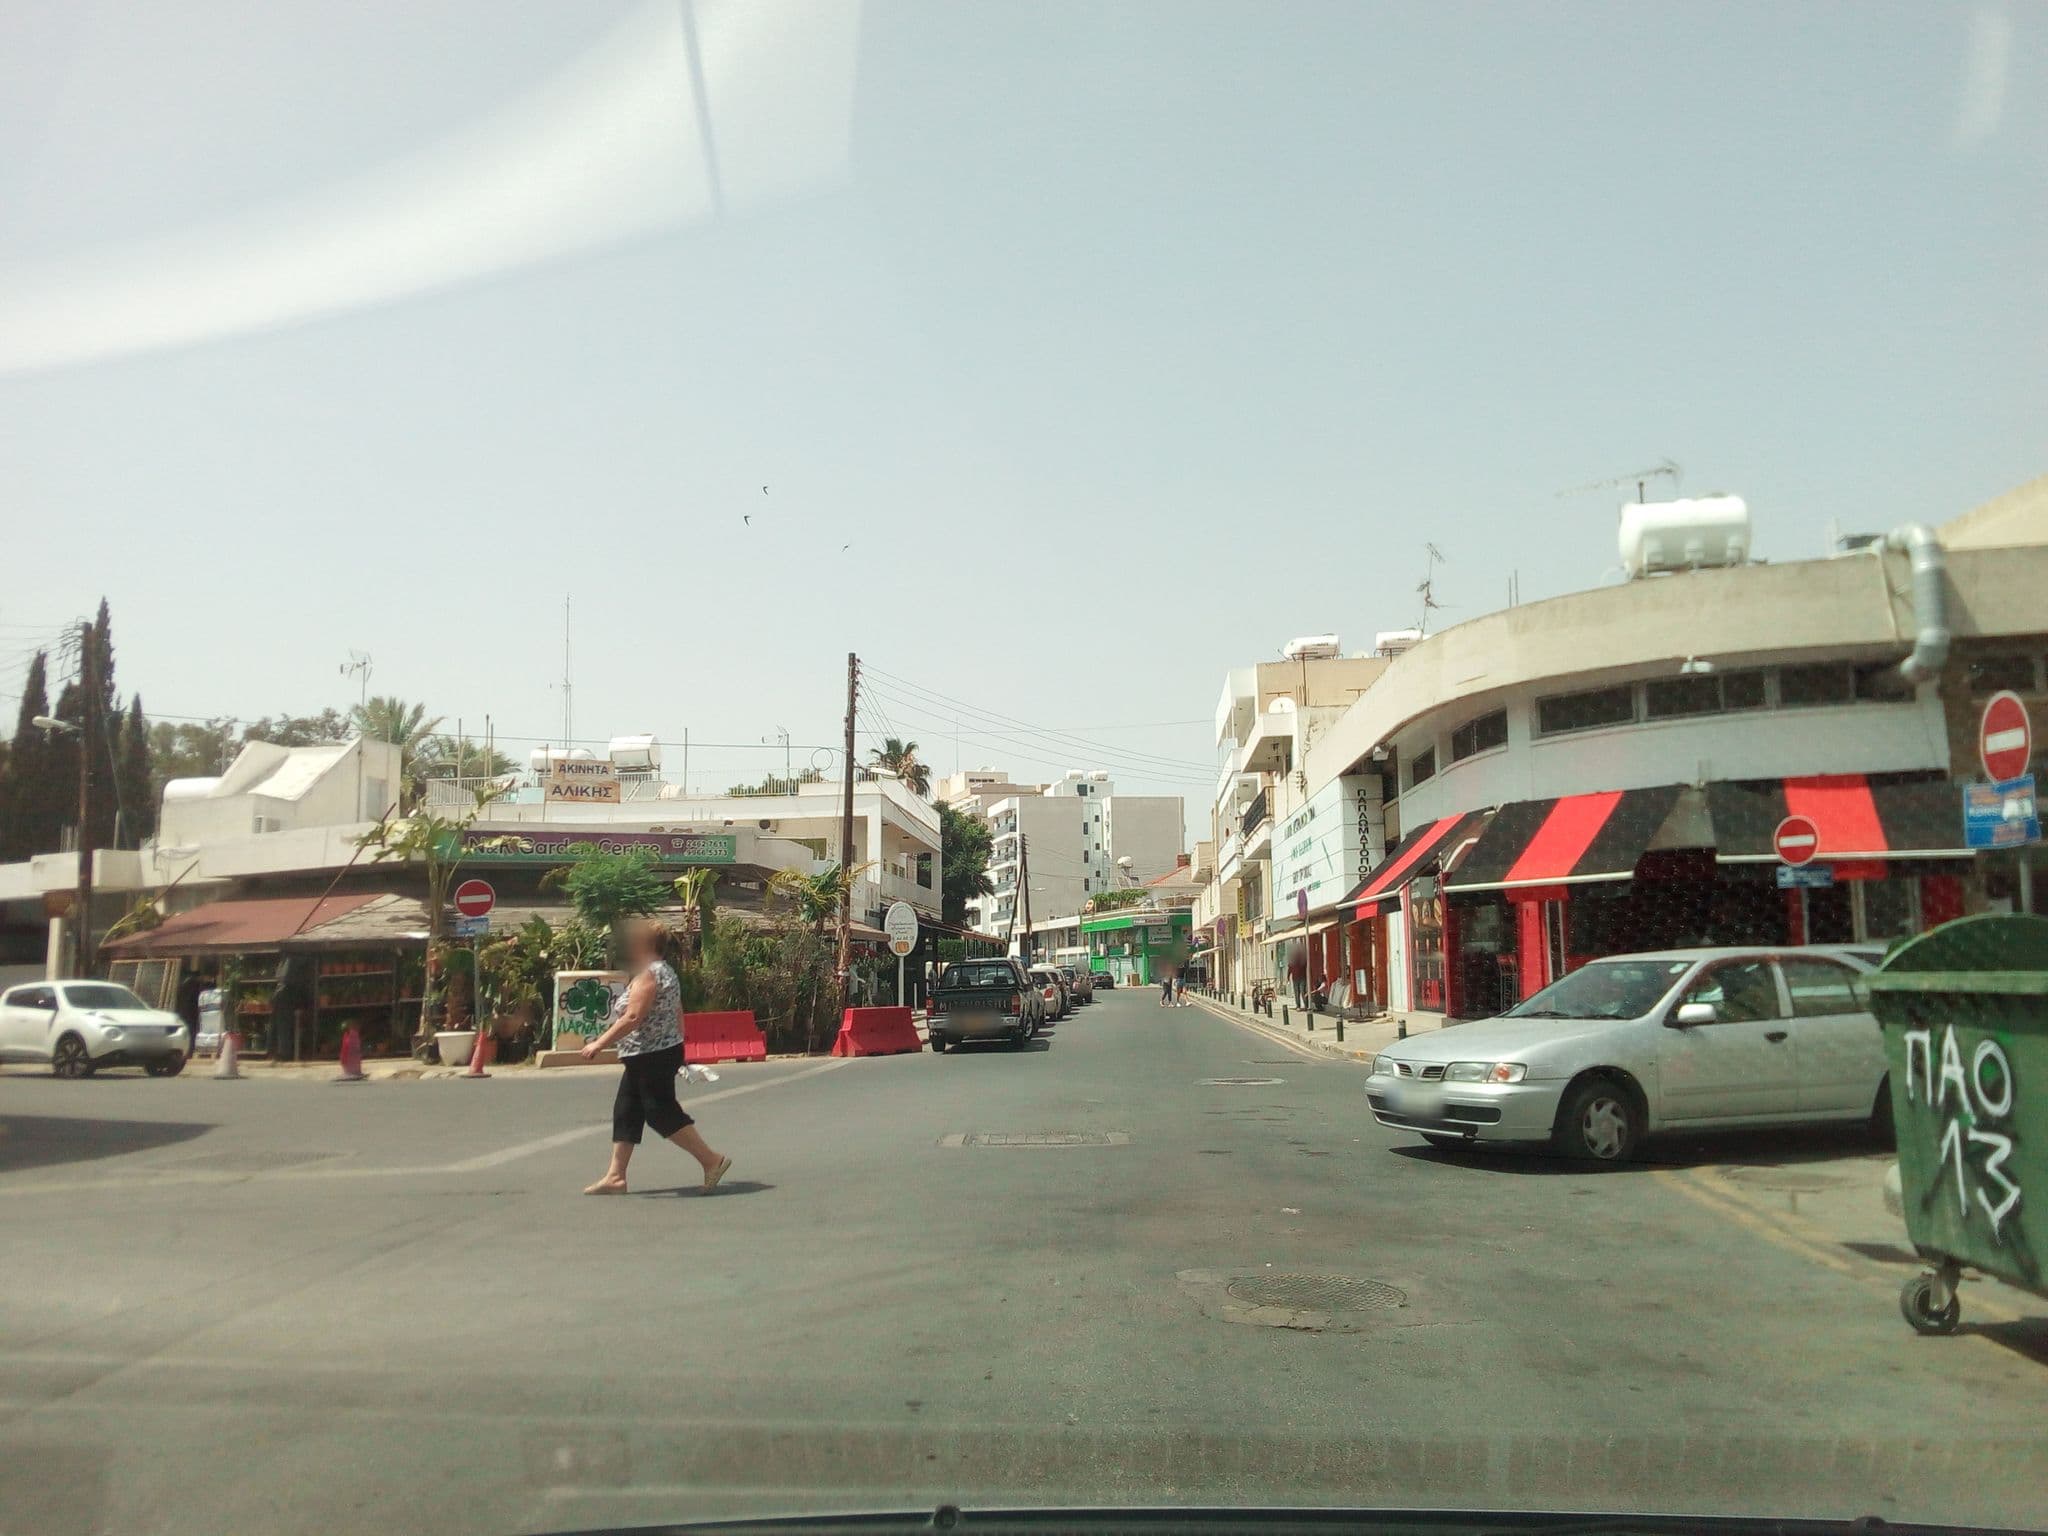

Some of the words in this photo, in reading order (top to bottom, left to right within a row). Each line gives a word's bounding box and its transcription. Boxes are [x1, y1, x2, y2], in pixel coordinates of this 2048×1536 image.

[552, 784, 613, 798] ΑΛΙΚΗΣ
[559, 764, 609, 775] ΑΚΙΝΗΤΑ
[1904, 1024, 2012, 1124] ΠΑΟ
[1939, 1117, 2021, 1246] 13
